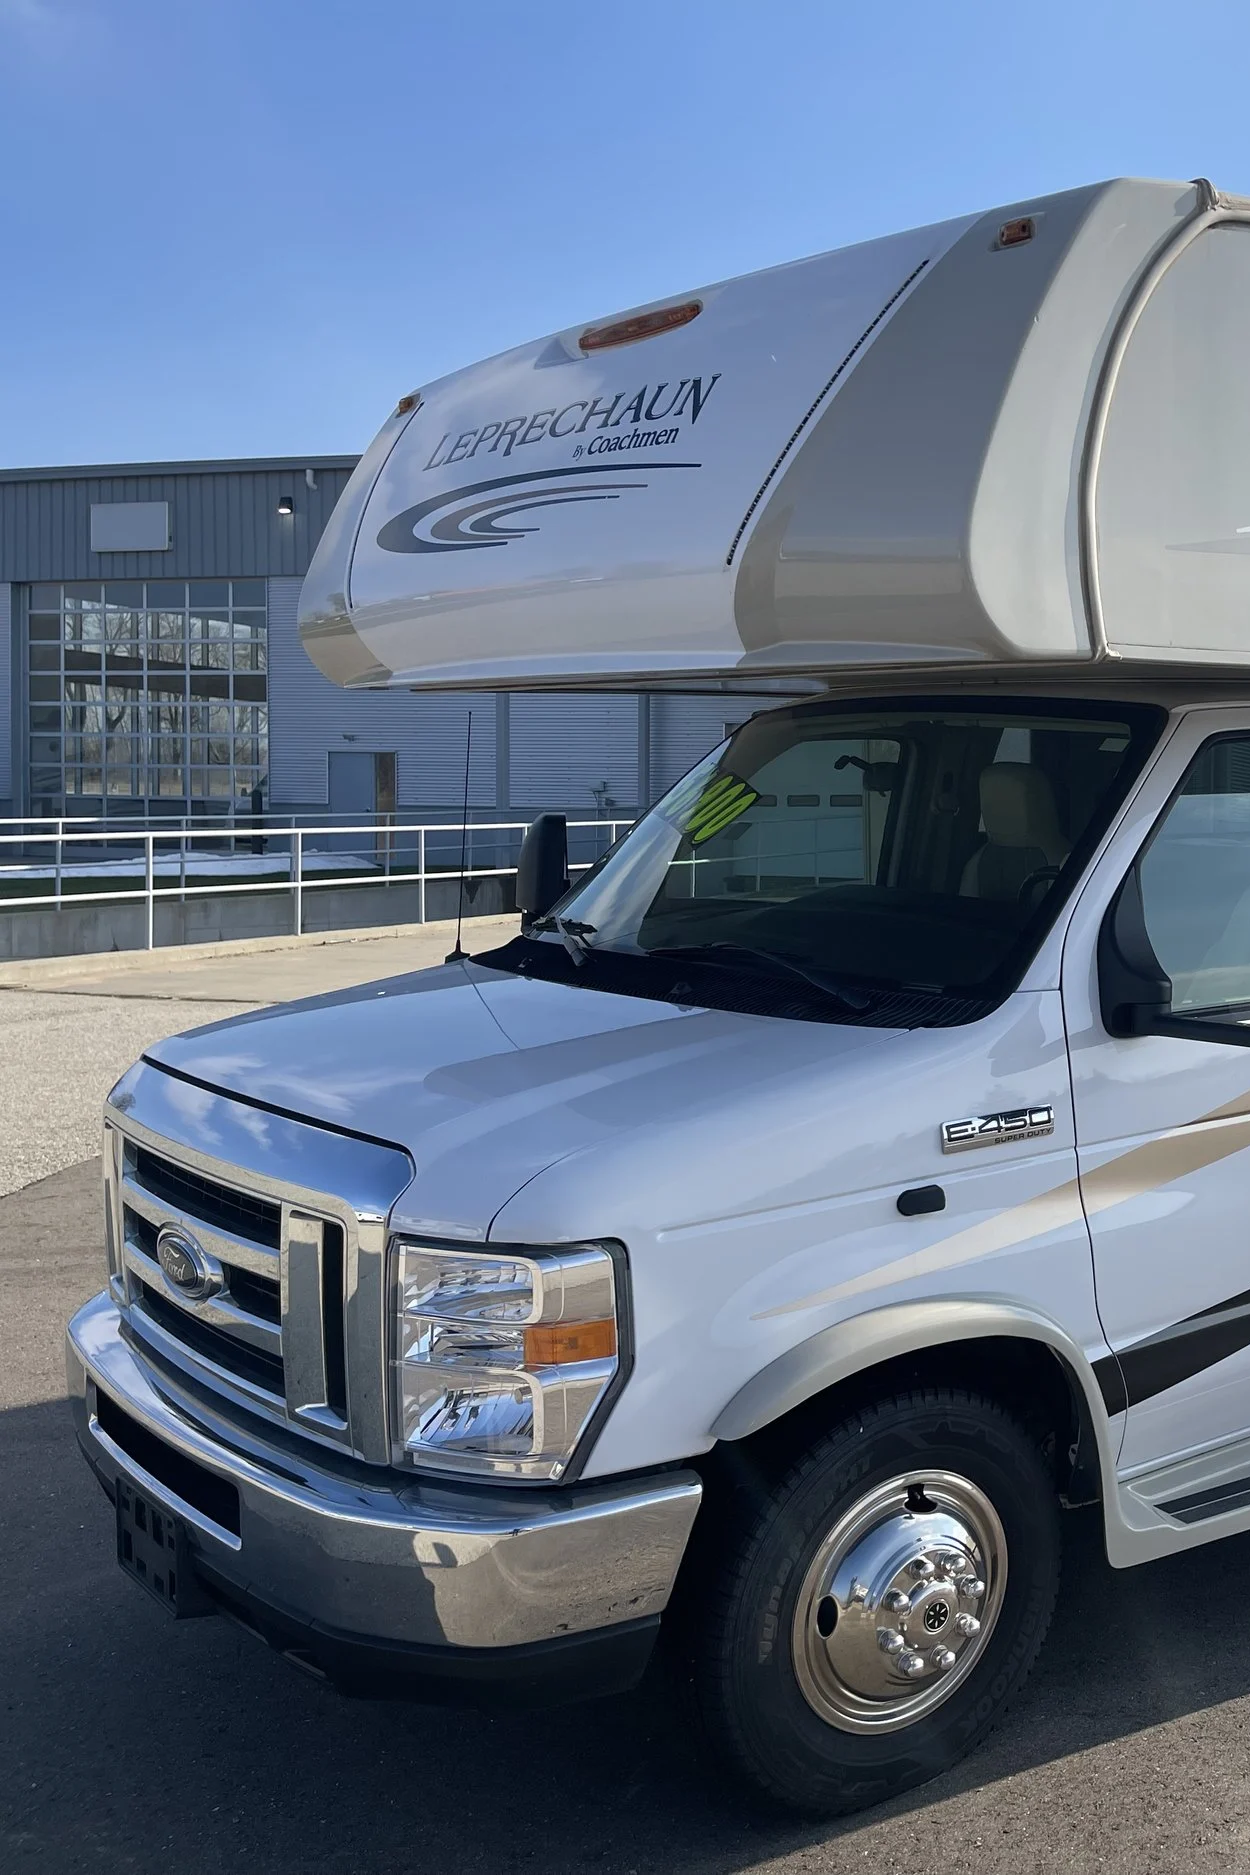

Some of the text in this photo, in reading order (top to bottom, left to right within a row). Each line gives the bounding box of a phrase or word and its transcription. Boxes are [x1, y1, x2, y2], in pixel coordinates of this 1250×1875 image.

[423, 373, 722, 471] LEPRECHAUN
[587, 426, 680, 457] Coachmen
[946, 1106, 1053, 1143] E-450
[994, 1126, 1052, 1144] SUPER DUTY
[163, 1246, 186, 1281] Ford
